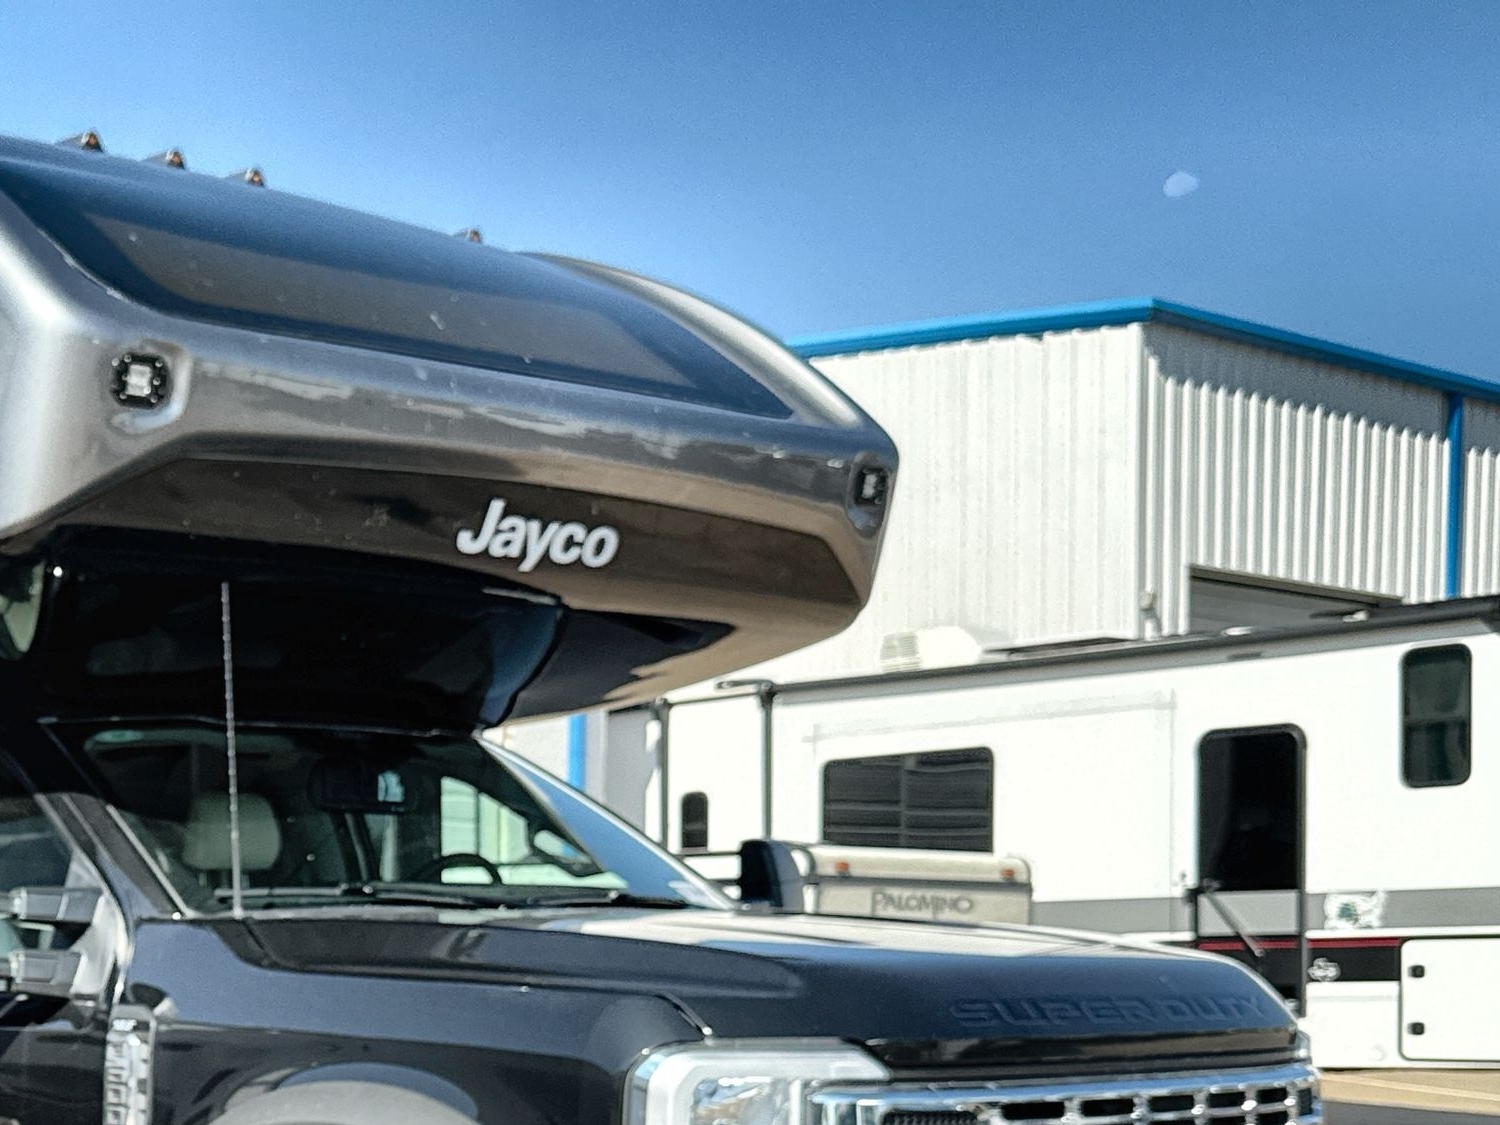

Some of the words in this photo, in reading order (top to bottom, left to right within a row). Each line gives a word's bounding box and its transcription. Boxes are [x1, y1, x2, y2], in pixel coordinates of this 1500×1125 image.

[456, 497, 619, 573] Jayco
[950, 999, 1157, 1027] SUPER
[1160, 998, 1267, 1022] DUTY
